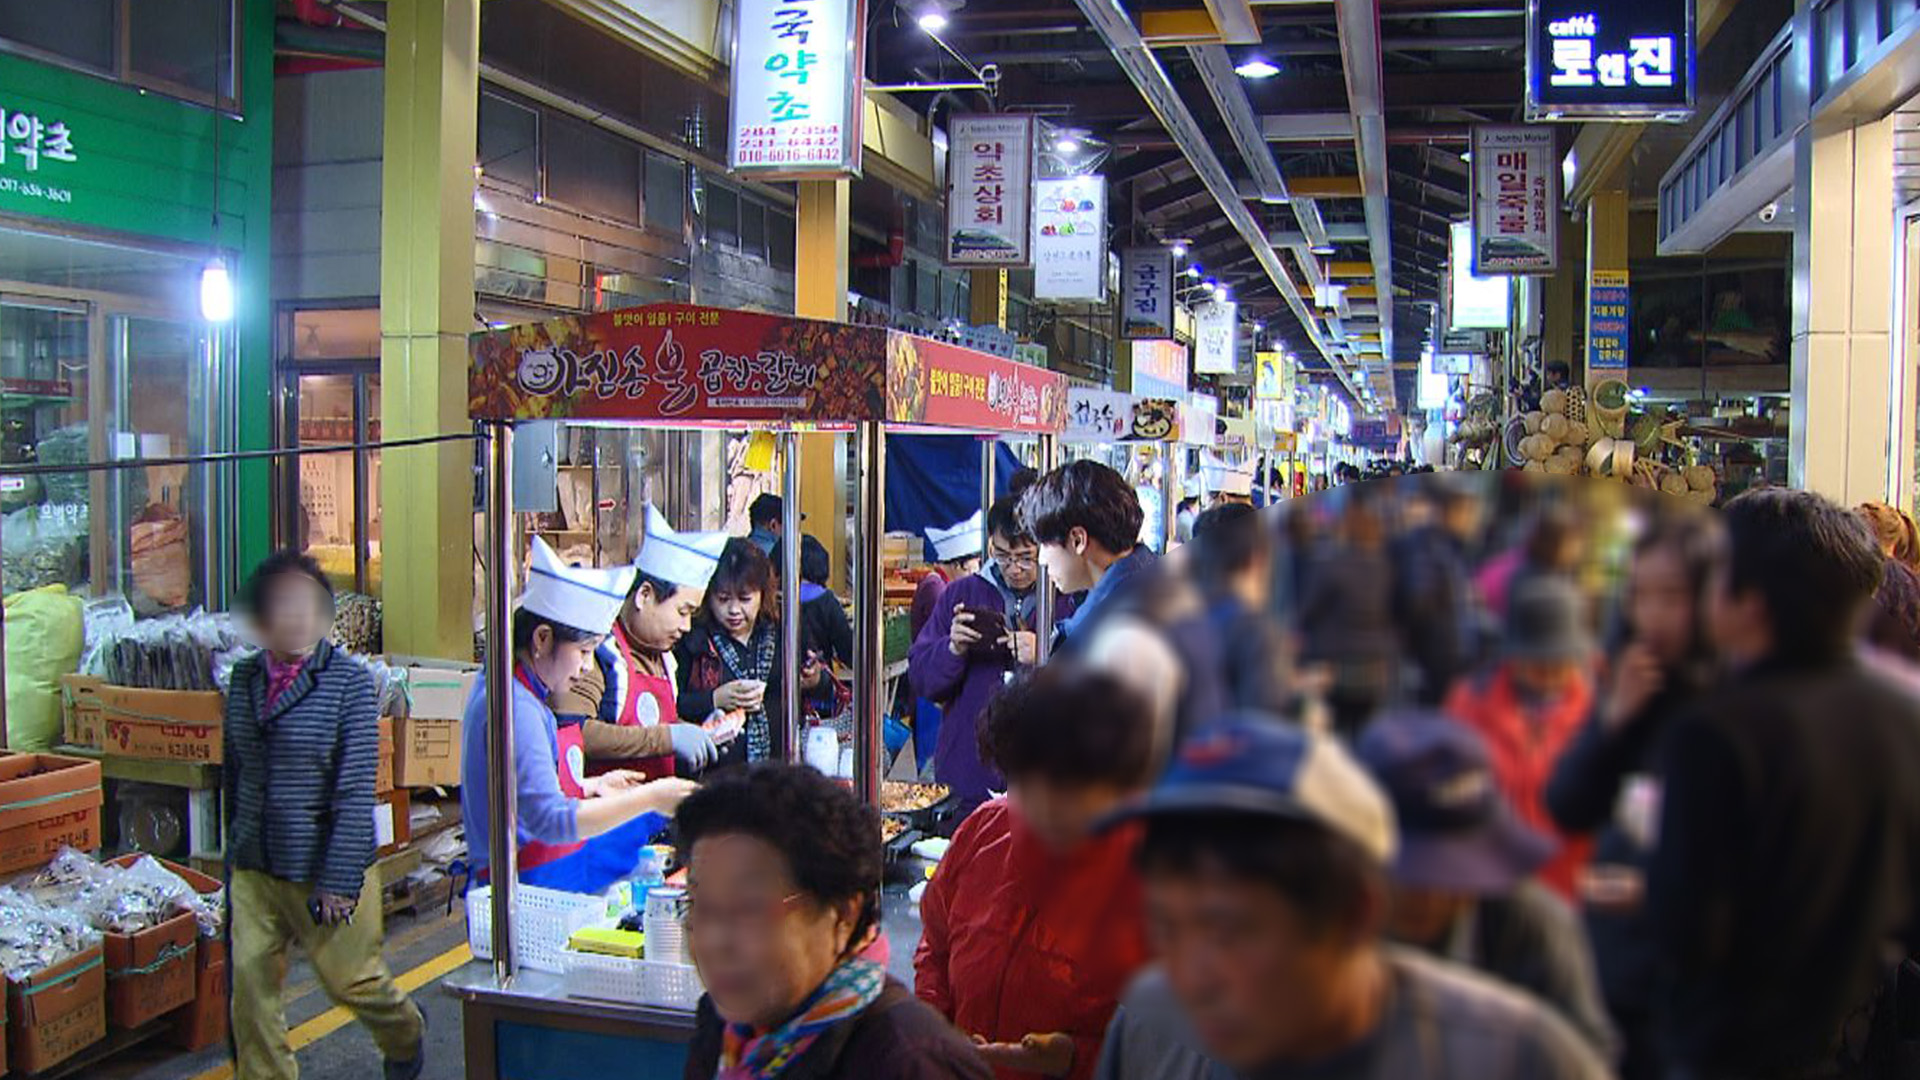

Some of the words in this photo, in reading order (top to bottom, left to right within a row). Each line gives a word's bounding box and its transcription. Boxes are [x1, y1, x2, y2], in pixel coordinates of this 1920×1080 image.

[0, 107, 77, 171] 약초
[973, 142, 1005, 225] 약초상회
[675, 311, 695, 326] 구이
[699, 311, 719, 326] 전문
